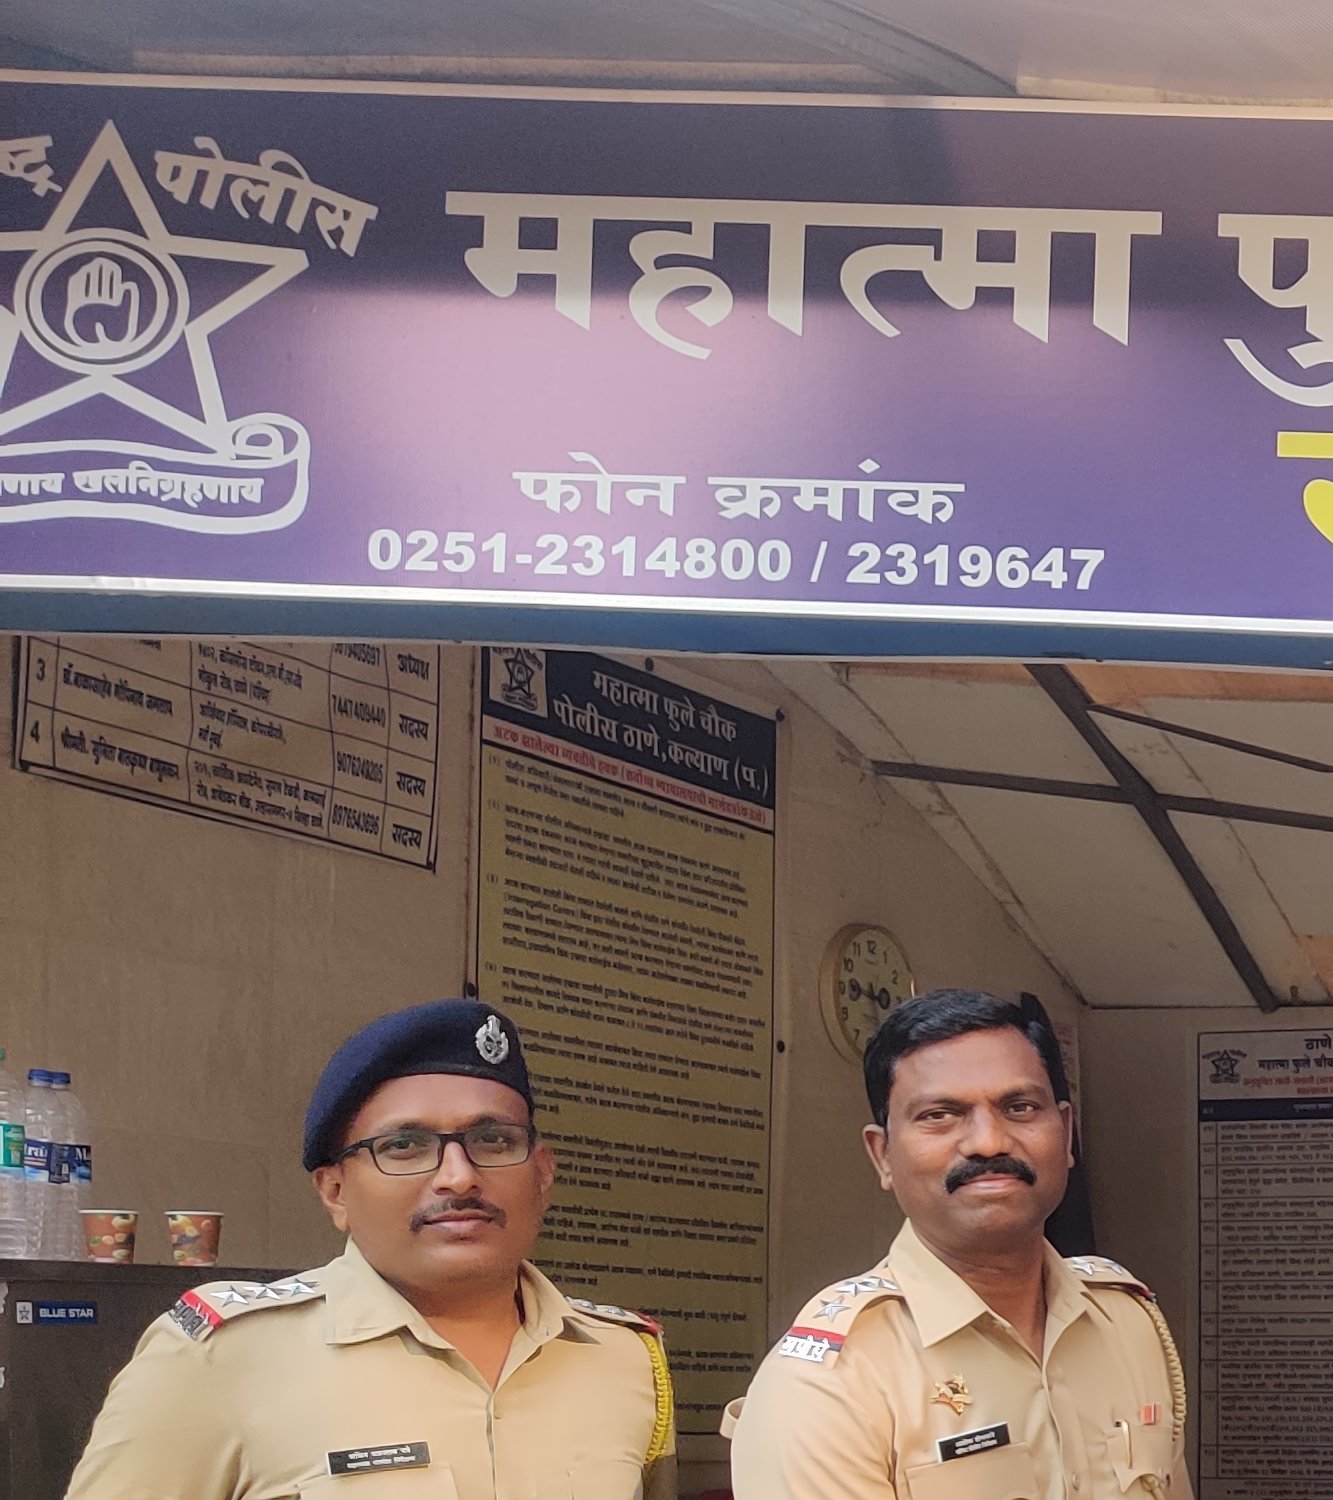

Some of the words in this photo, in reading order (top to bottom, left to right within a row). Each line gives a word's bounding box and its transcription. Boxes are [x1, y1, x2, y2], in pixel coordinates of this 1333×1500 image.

[154, 136, 379, 257] पोलीस
[446, 190, 1162, 359] महात्मा
[512, 452, 687, 517] फोन
[707, 459, 965, 525] क्रमांक
[367, 528, 793, 582] 0251-2314800
[846, 543, 1106, 591] 2319647
[36, 658, 46, 681] 3
[553, 693, 619, 743] पोलीस
[593, 670, 660, 716] महात्मा
[664, 695, 696, 732] फुले
[700, 704, 738, 742] चौक
[30, 720, 40, 743] 4
[399, 713, 429, 741] सदस्य
[396, 771, 426, 797] सदस्य
[392, 823, 422, 849] सदस्य
[1305, 1034, 1332, 1050] ठाणे
[39, 1308, 66, 1318] BLUE
[69, 1308, 94, 1318] STAR
